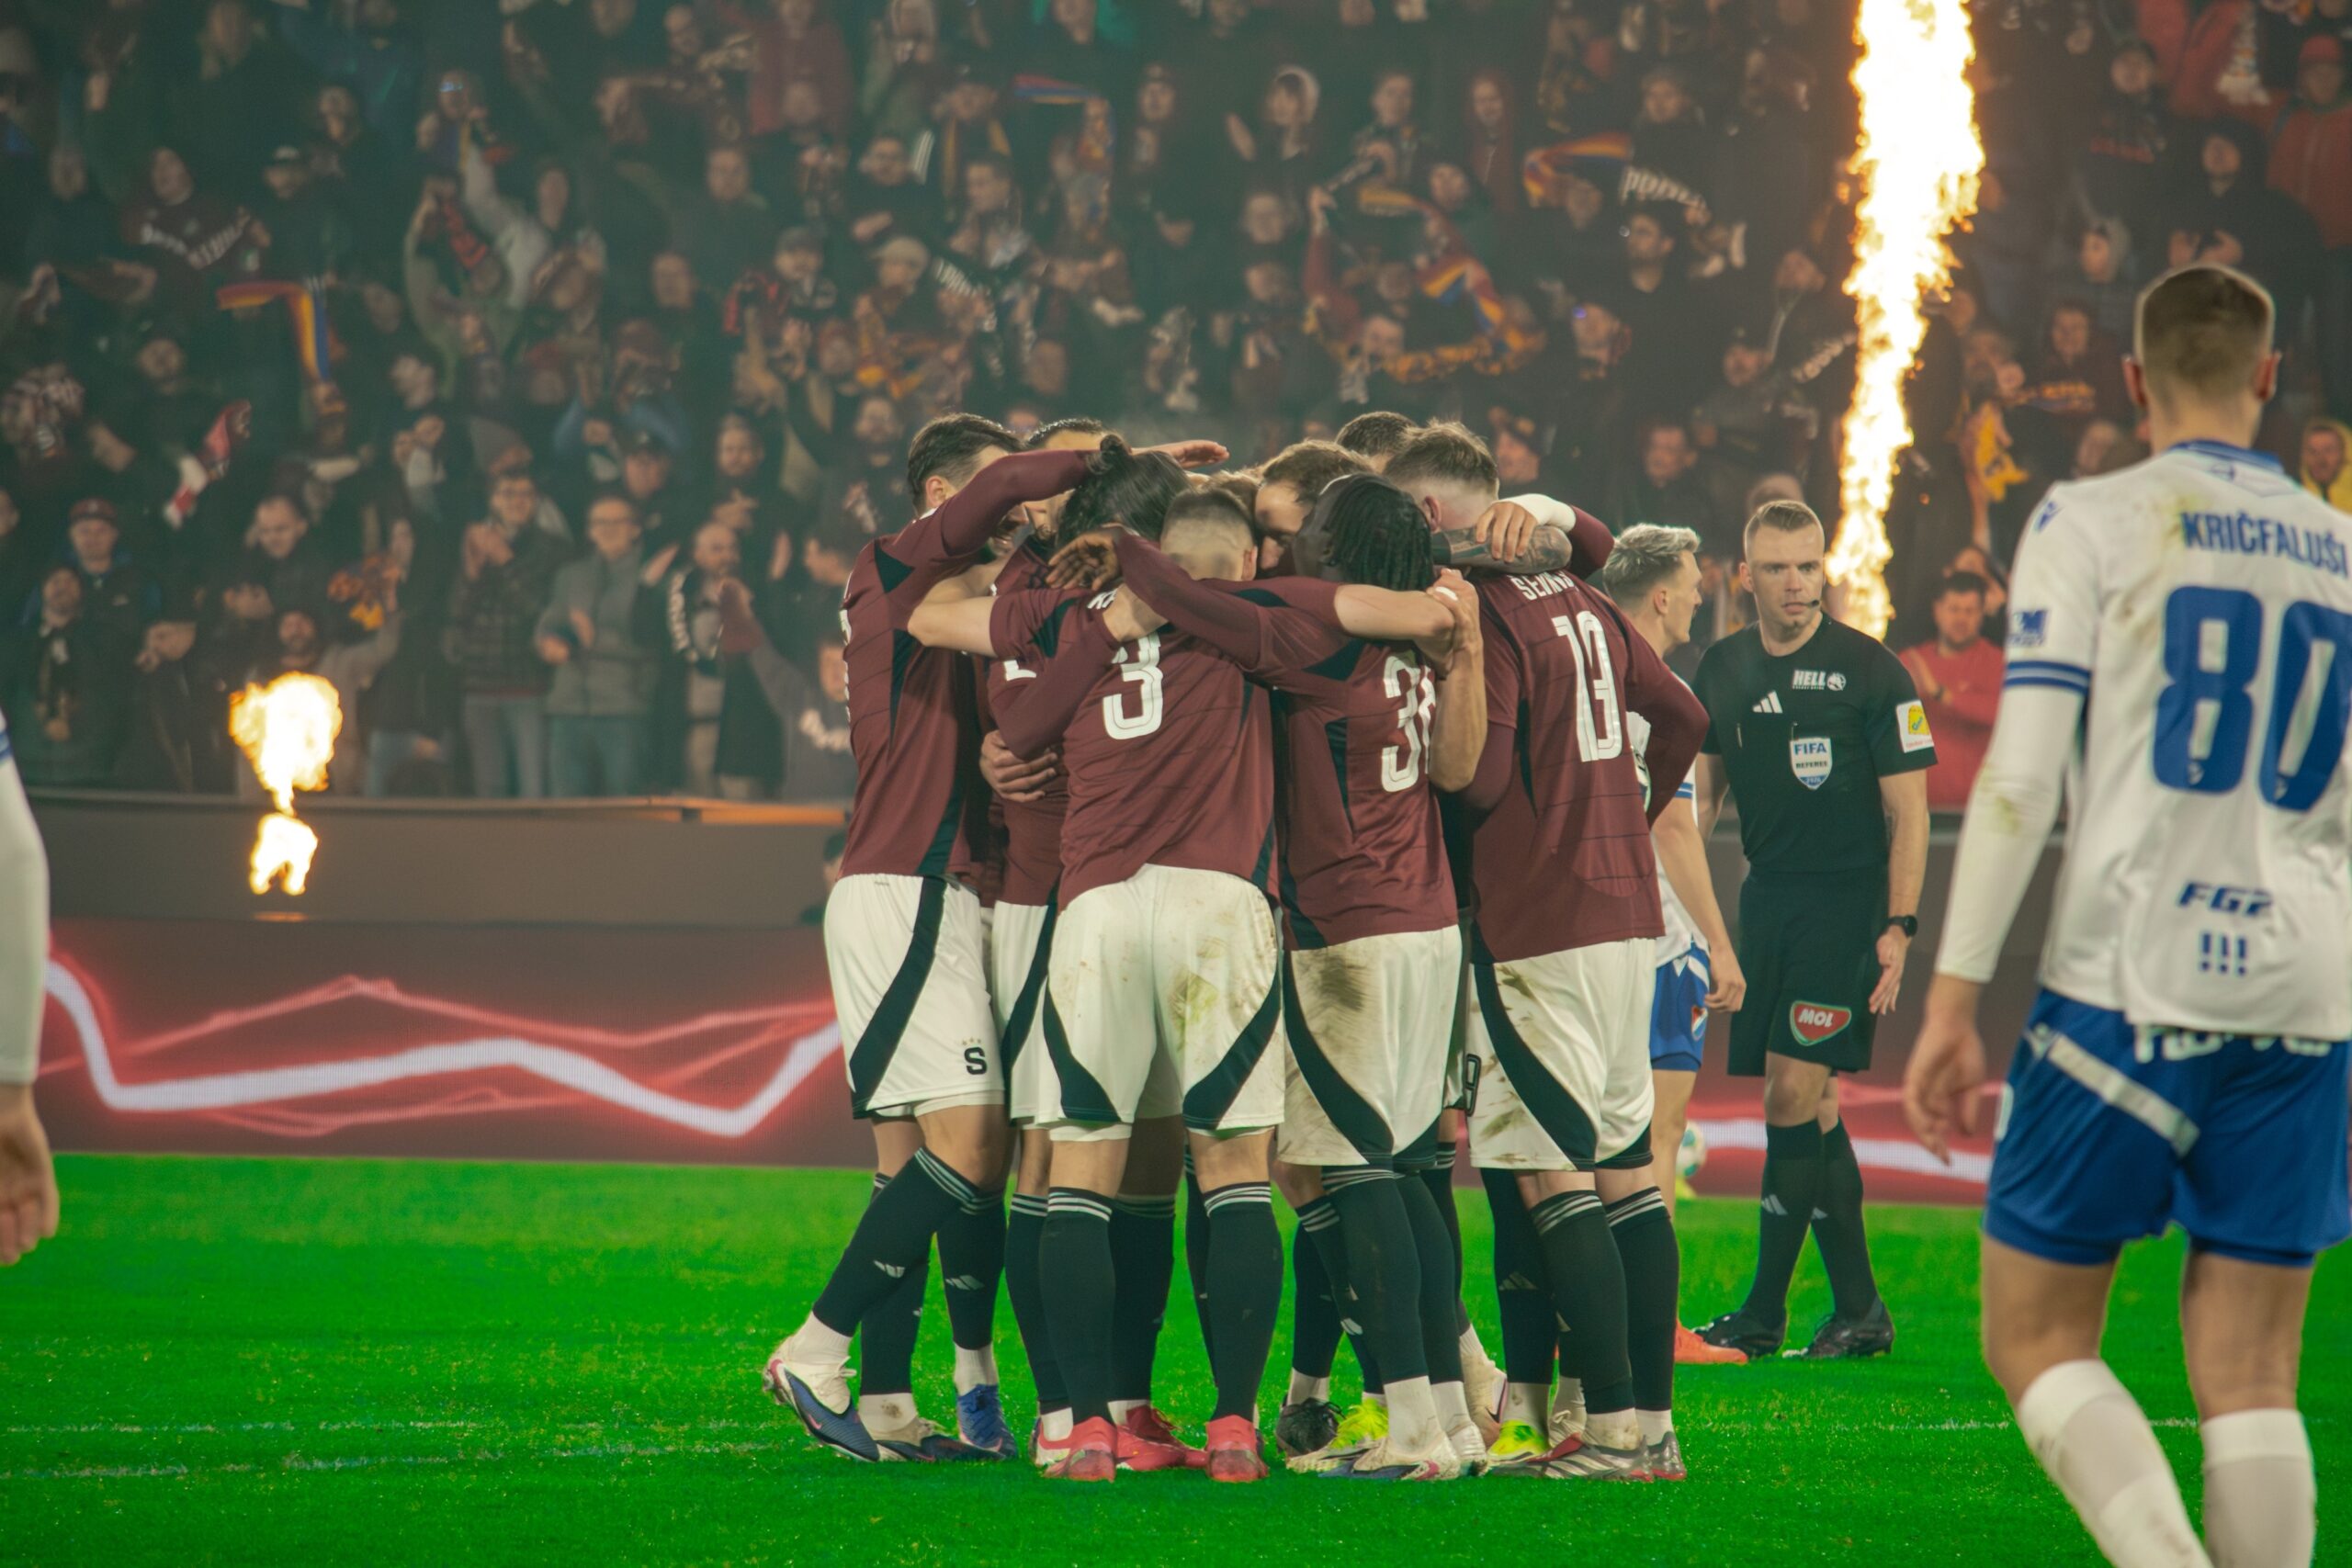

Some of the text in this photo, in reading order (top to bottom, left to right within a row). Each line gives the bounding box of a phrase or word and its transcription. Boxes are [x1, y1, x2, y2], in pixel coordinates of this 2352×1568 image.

[2181, 510, 2348, 580] KRIČFALUŠI
[1792, 670, 1826, 686] HELL
[2153, 585, 2352, 815] 80
[1794, 742, 1827, 755] FIFA
[1795, 761, 1826, 770] REFEREE
[1798, 1008, 1834, 1028] MOL
[964, 1046, 988, 1076] S
